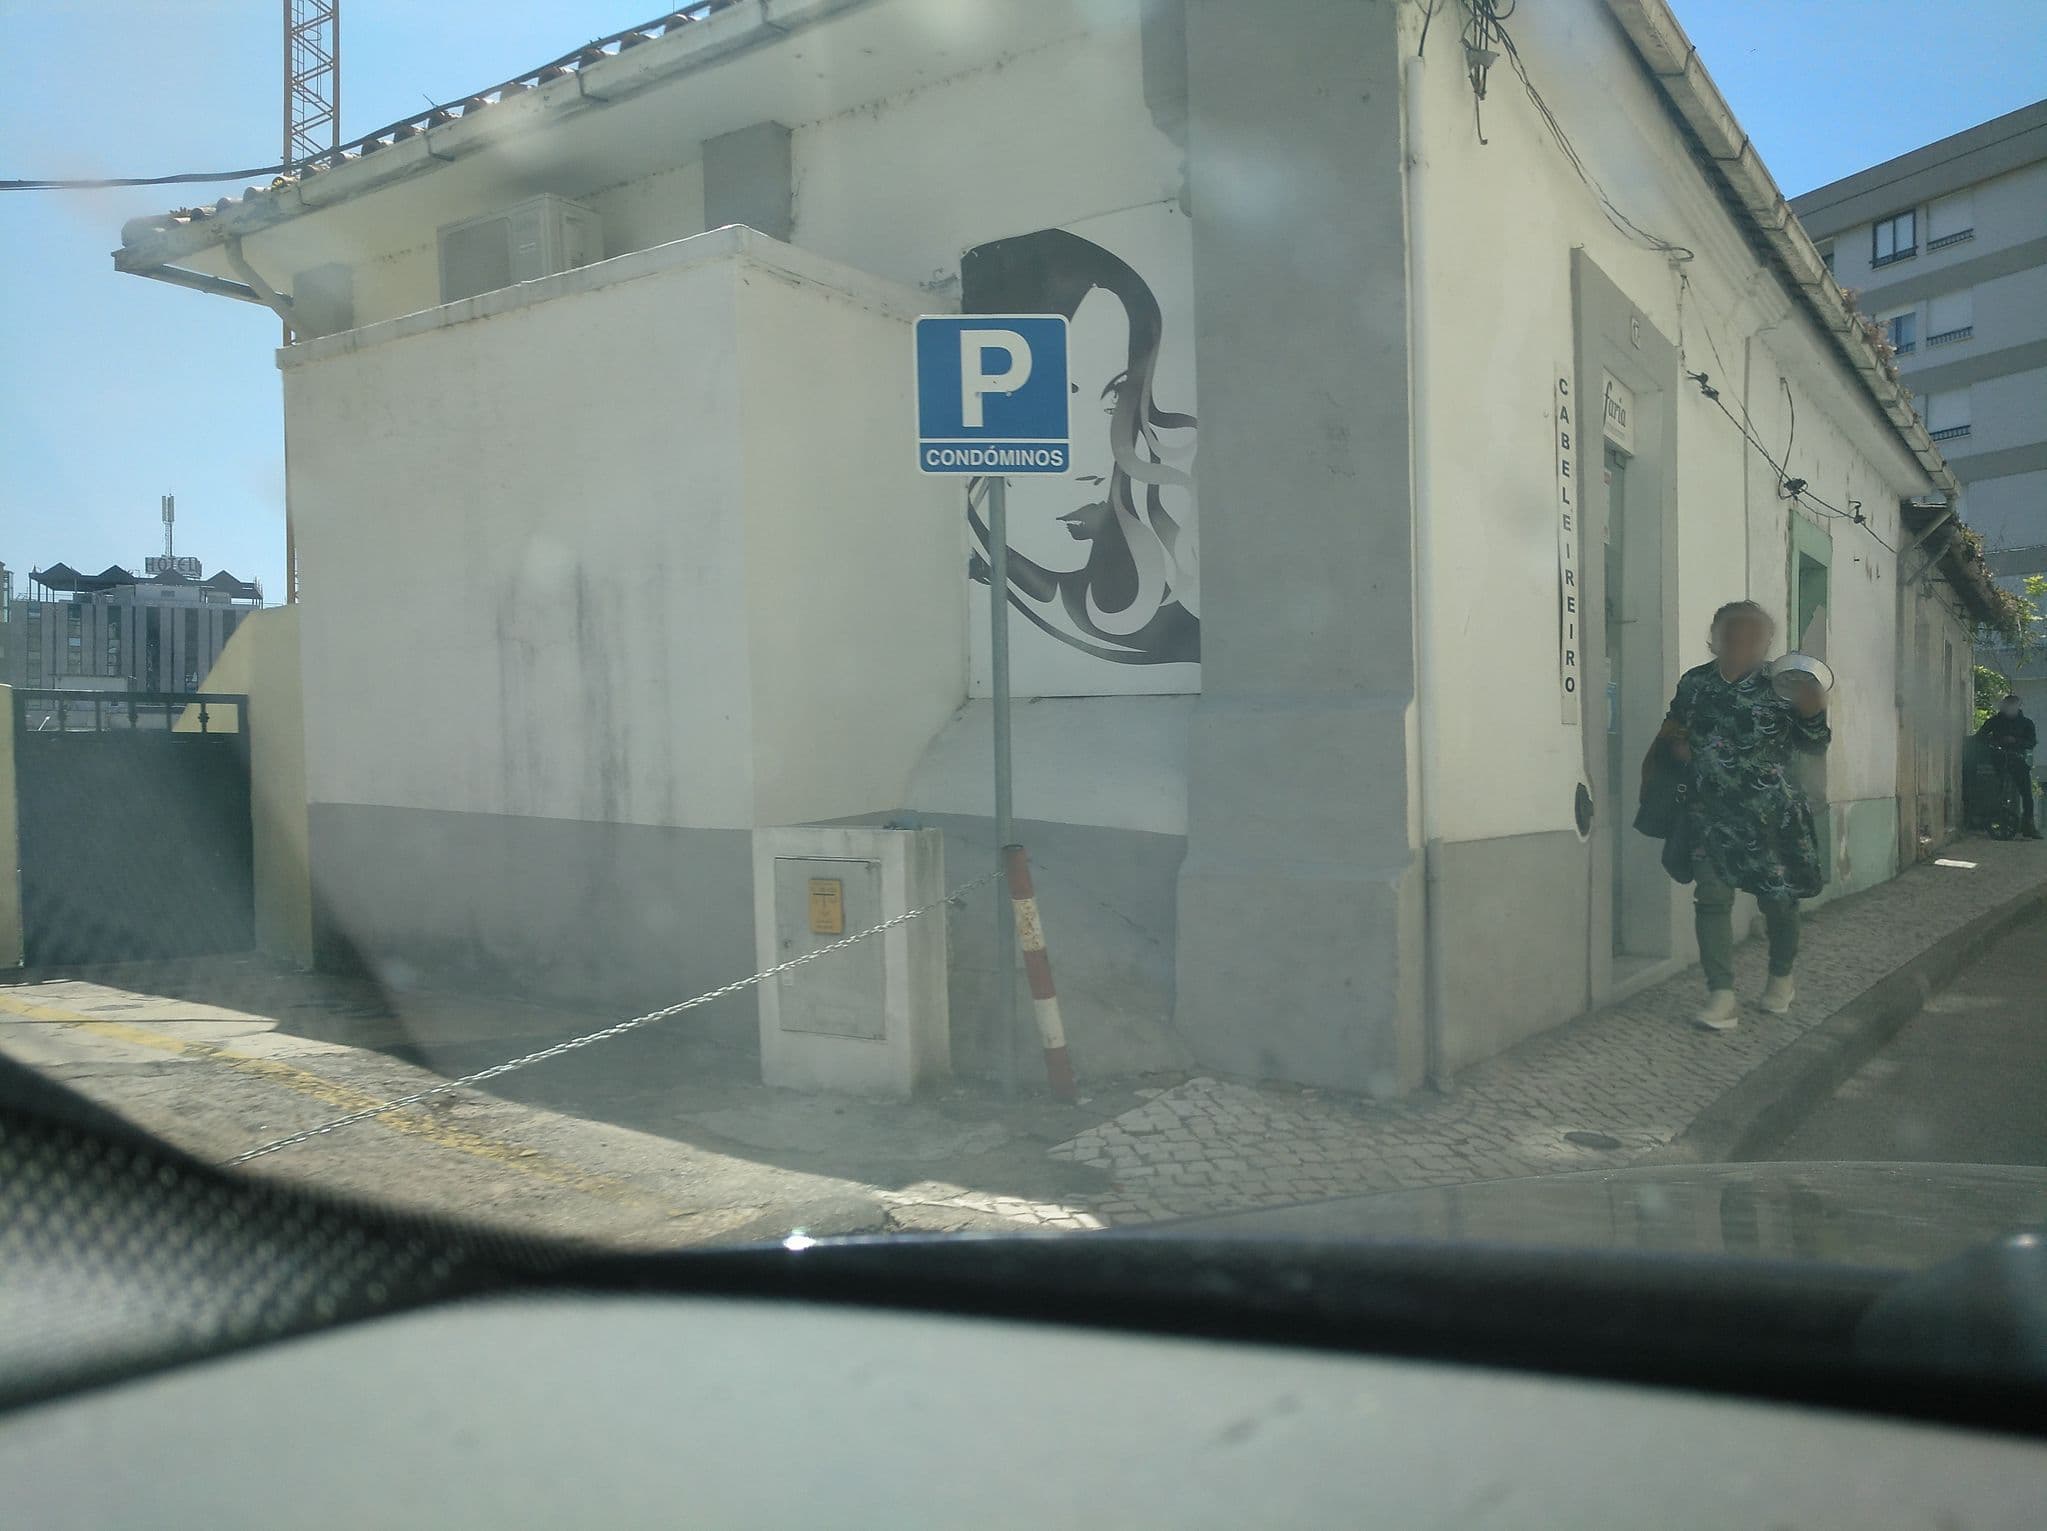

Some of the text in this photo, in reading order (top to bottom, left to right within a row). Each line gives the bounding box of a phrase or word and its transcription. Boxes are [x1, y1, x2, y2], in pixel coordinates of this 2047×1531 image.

[960, 330, 1032, 427] P
[1603, 380, 1626, 428] faria
[926, 445, 1064, 466] CONDÓMINOS
[1559, 378, 1575, 693] CABELEIREIRO
